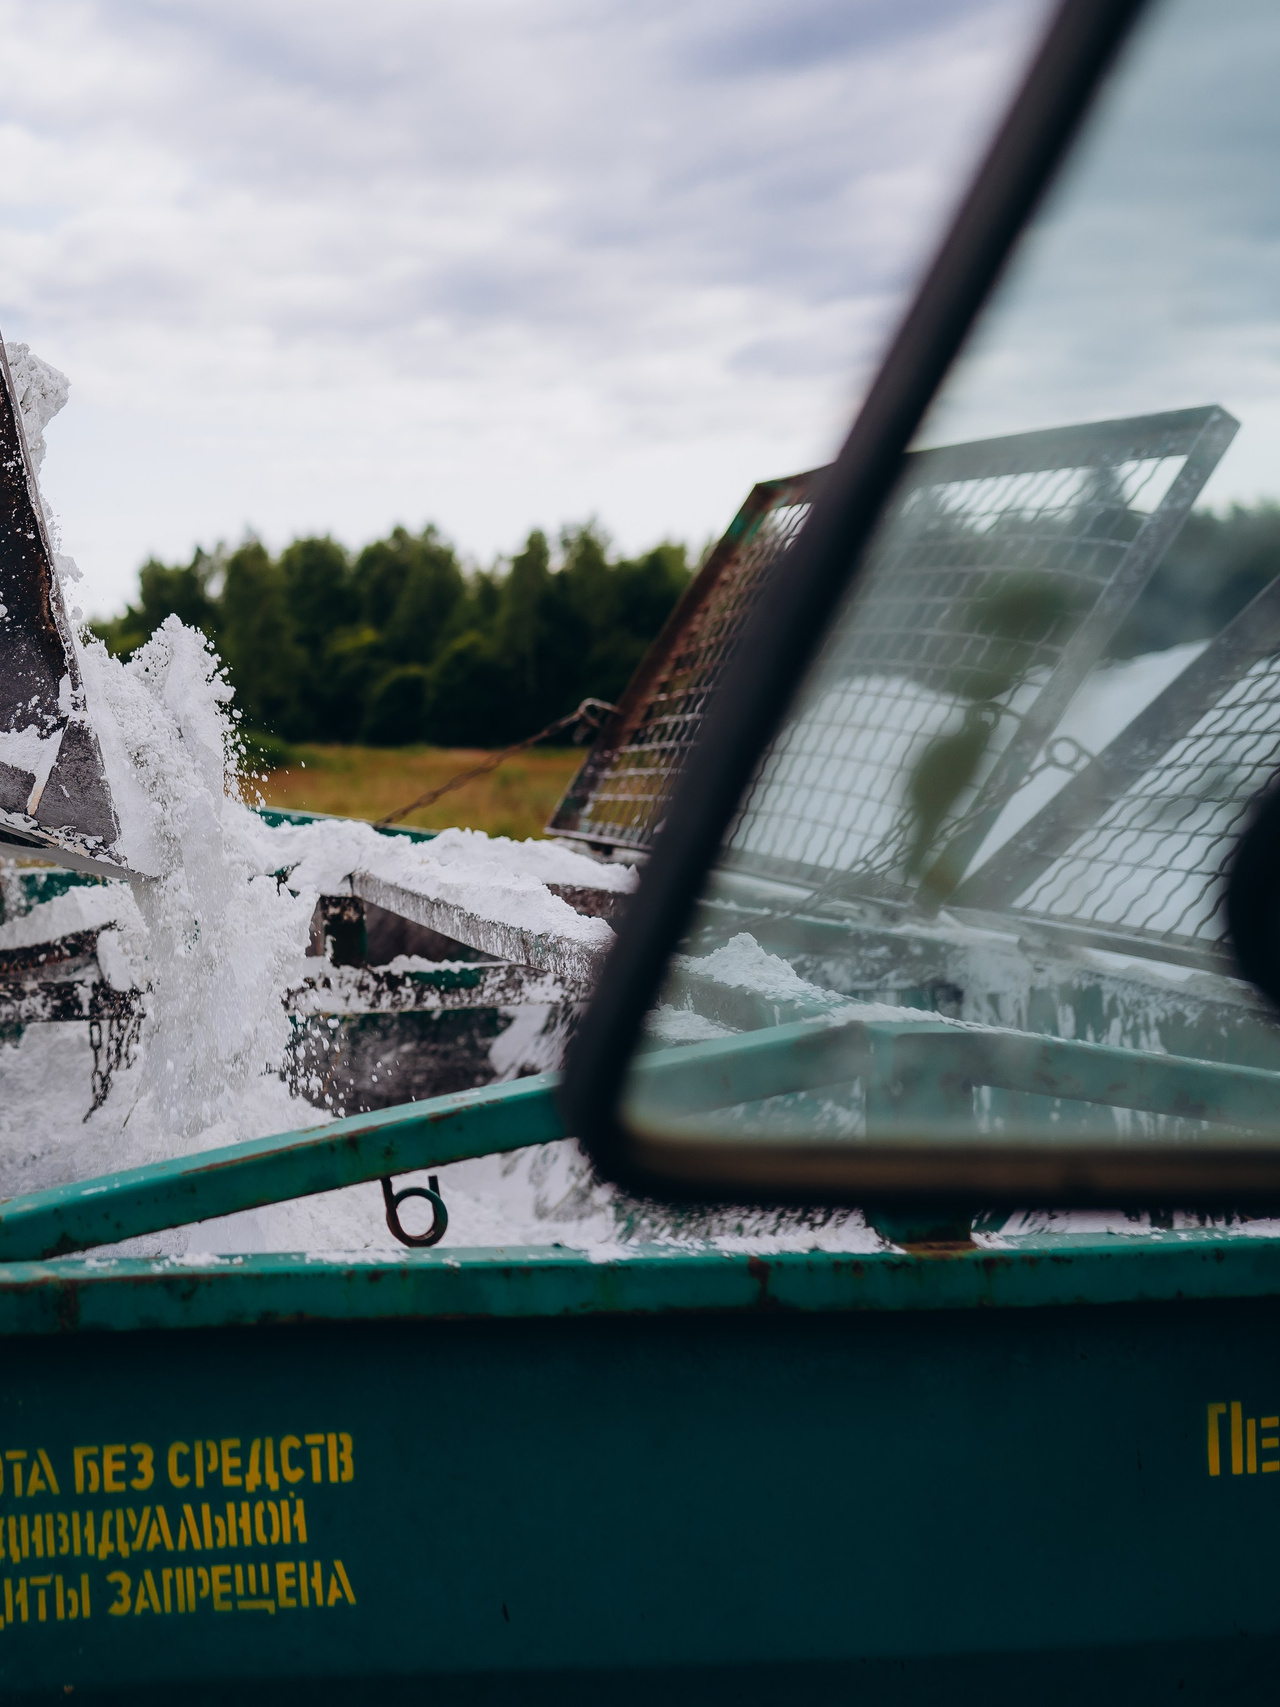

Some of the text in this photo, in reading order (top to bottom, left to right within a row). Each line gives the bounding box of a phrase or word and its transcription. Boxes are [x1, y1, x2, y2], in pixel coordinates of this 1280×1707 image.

[73, 1443, 155, 1494] БЕЗ
[167, 1432, 354, 1493] СРЕДСТВ
[106, 1559, 357, 1616] ЗАПРЕЩЕНА
